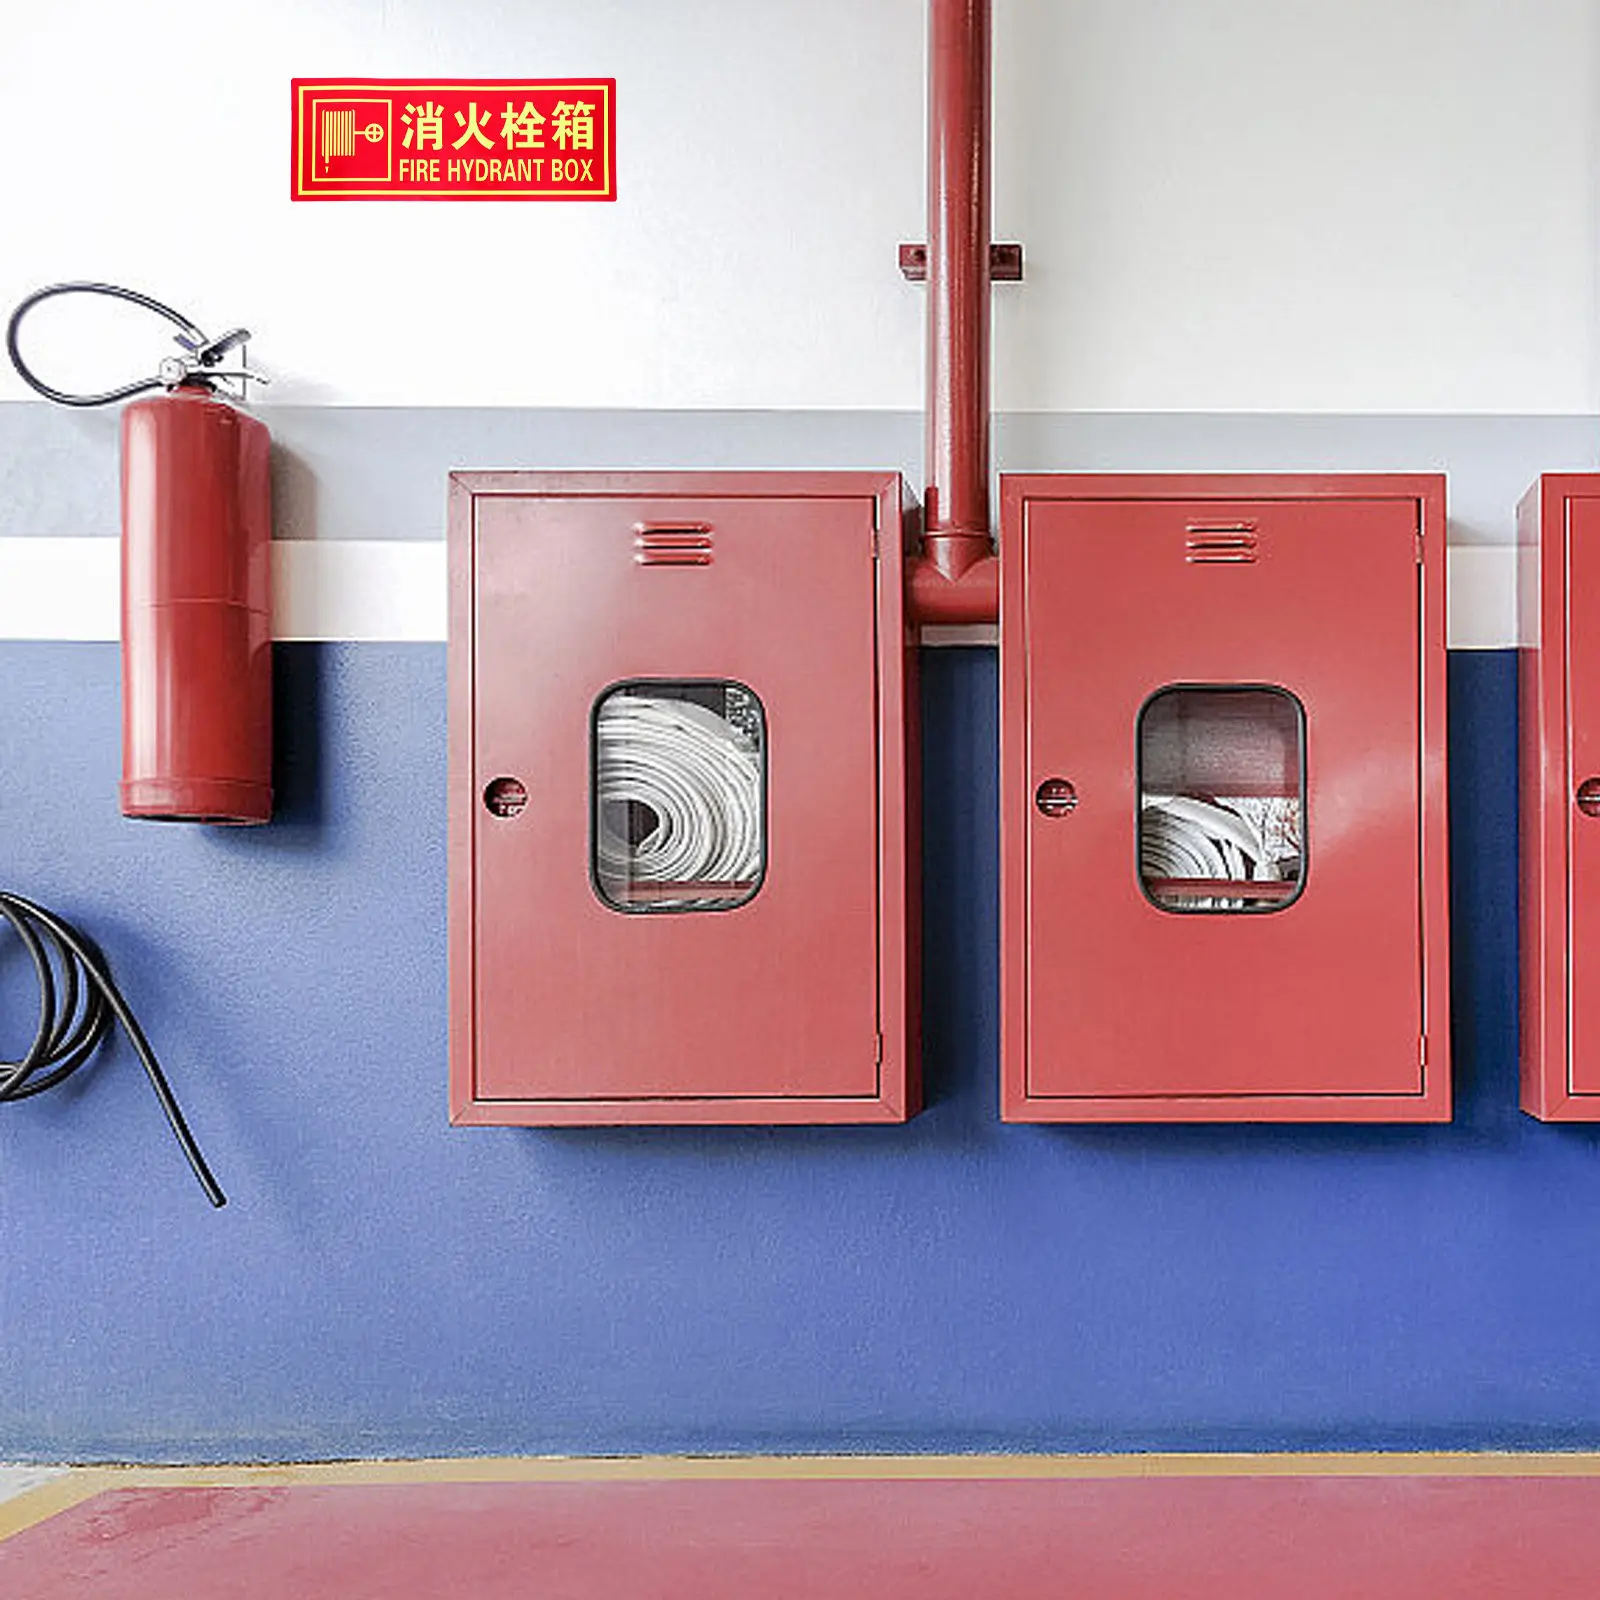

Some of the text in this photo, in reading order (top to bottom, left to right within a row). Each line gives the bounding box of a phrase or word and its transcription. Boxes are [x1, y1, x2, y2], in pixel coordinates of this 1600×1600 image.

[400, 101, 596, 151] 消火栓箱
[399, 158, 594, 182] FIRE HYDRANT BOX
